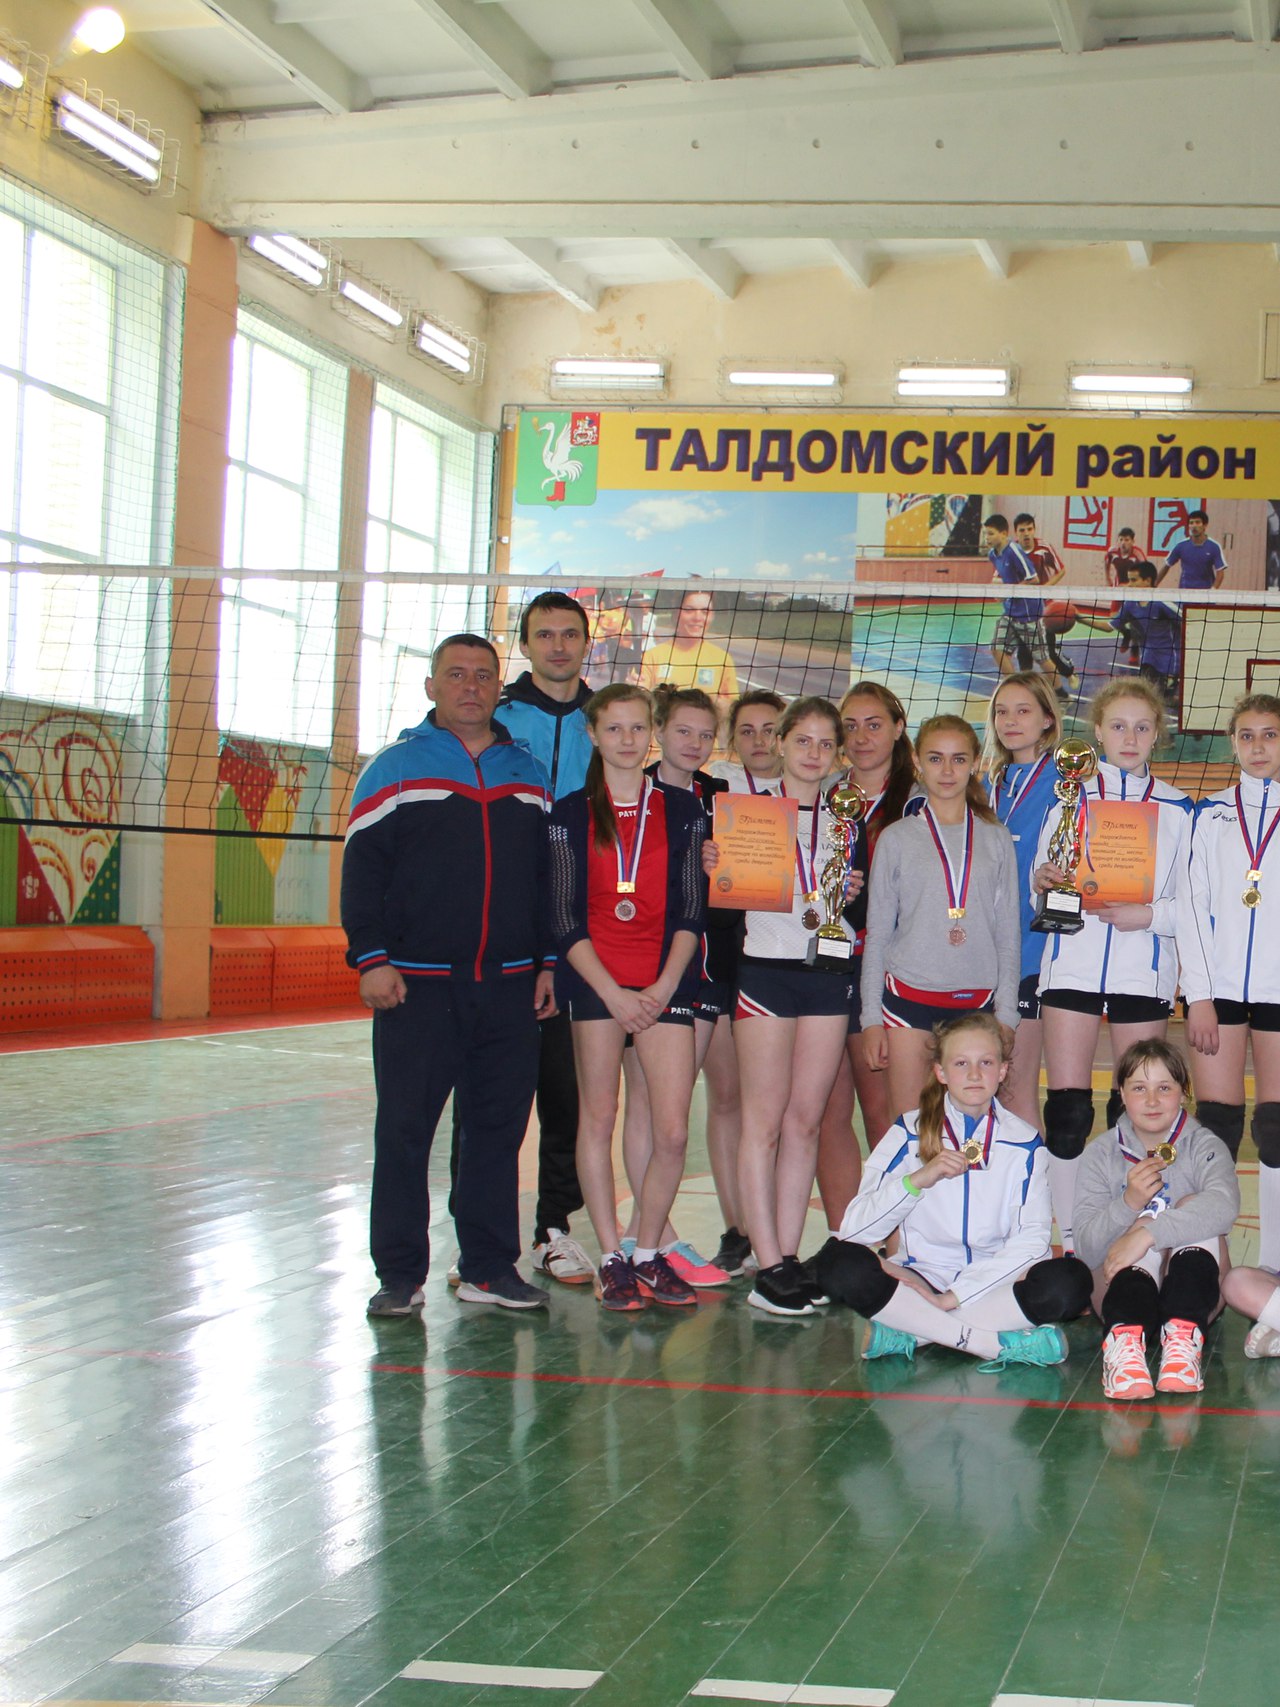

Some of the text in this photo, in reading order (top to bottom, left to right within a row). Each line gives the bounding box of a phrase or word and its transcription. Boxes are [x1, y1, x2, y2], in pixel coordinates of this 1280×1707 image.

[635, 423, 1257, 488] ТАЛДОМСКИЙ район
[618, 809, 652, 818] PATK
